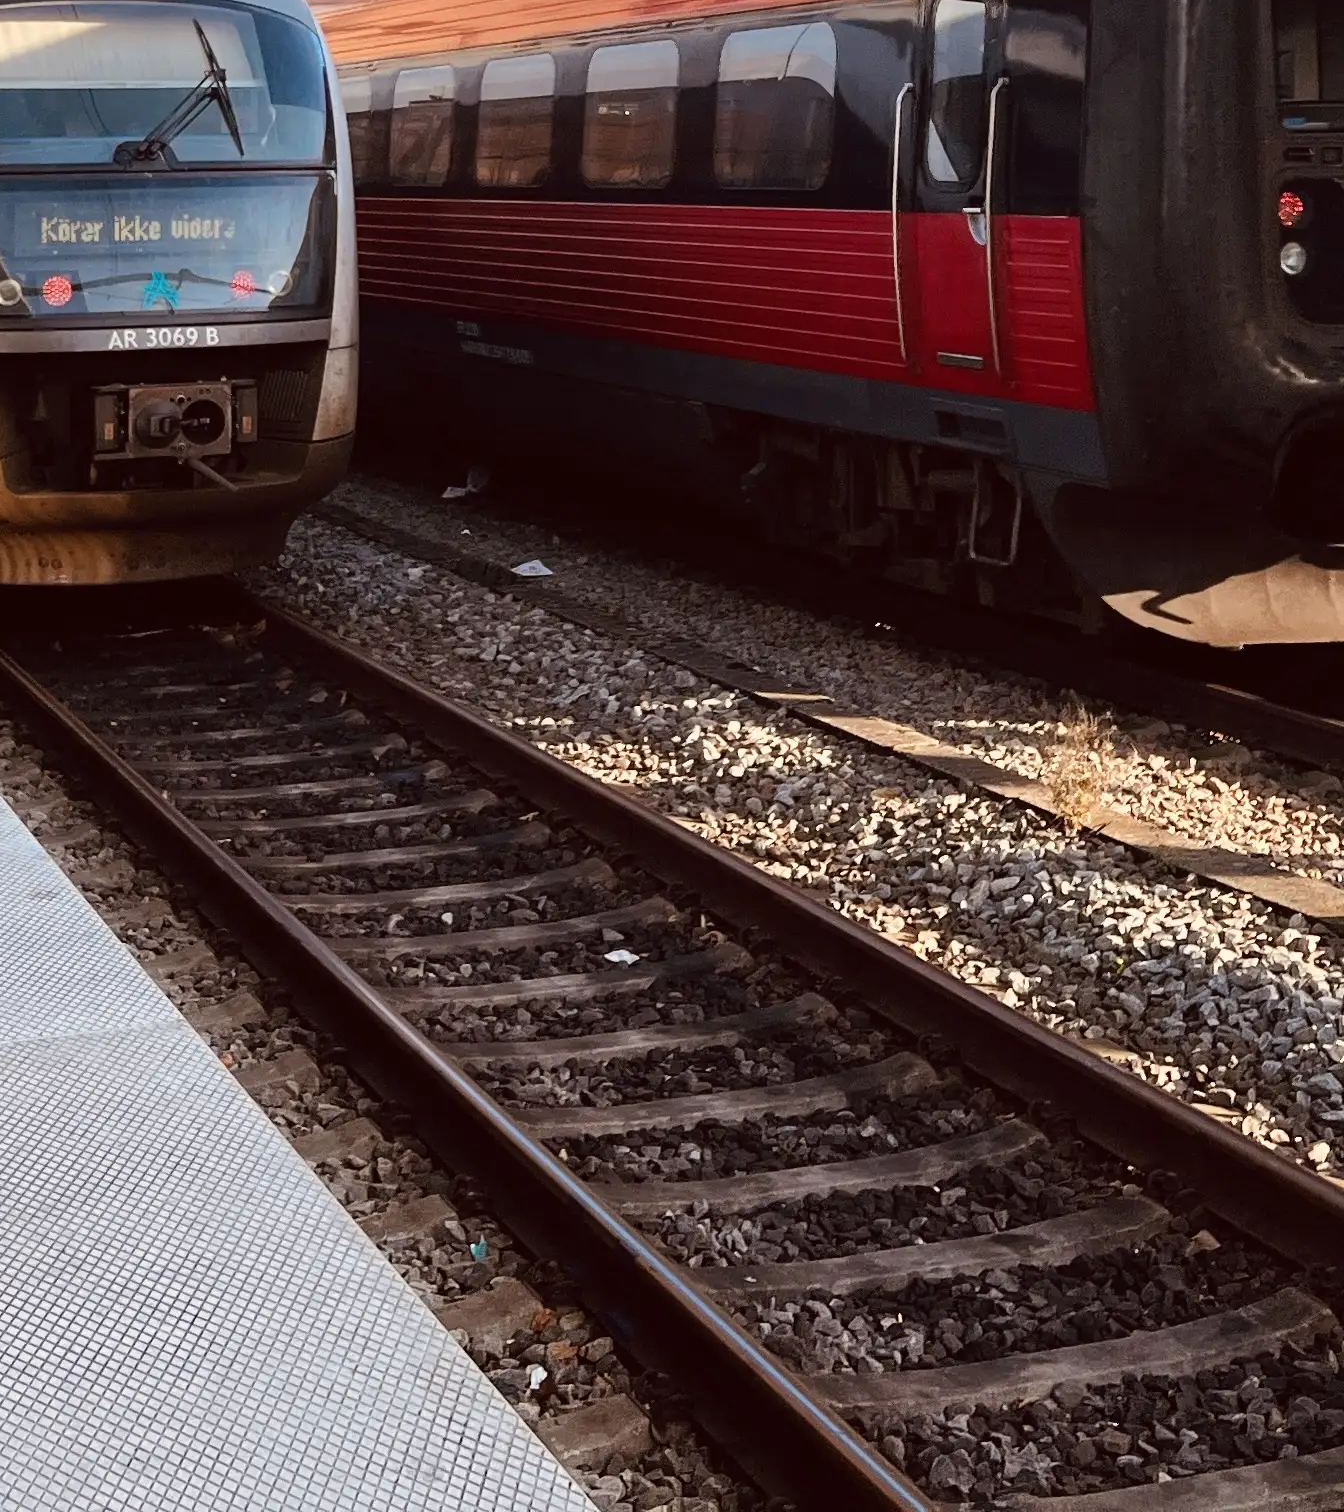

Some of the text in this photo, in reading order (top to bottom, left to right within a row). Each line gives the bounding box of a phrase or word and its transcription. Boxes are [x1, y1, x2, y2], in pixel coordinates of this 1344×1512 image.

[114, 215, 162, 242] ikke
[108, 327, 220, 350] AR 3069 B
